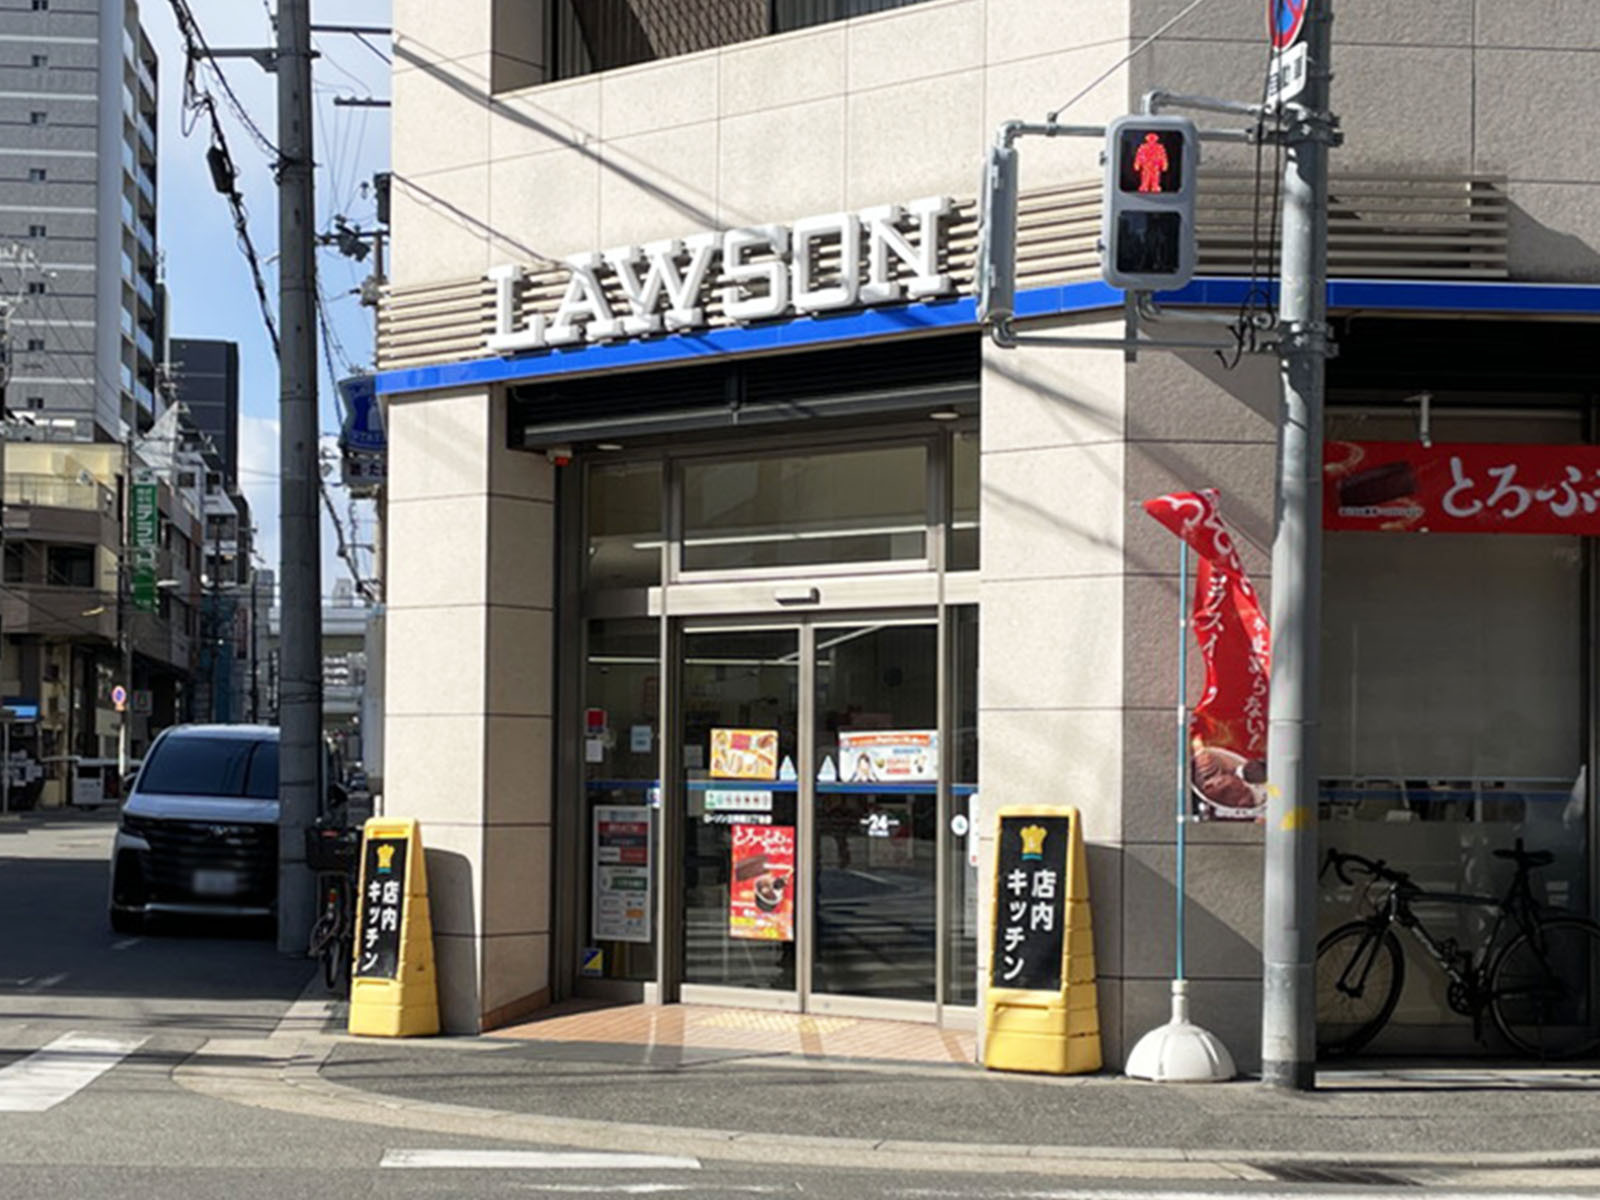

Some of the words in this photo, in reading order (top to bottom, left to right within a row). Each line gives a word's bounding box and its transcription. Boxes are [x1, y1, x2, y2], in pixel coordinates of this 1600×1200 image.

[486, 196, 952, 352] LAWSON
[868, 813, 889, 831] 24
[361, 880, 381, 972] キッチン
[381, 880, 400, 932] 店内
[1003, 868, 1028, 981] キッチン
[1030, 868, 1057, 932] 店内
